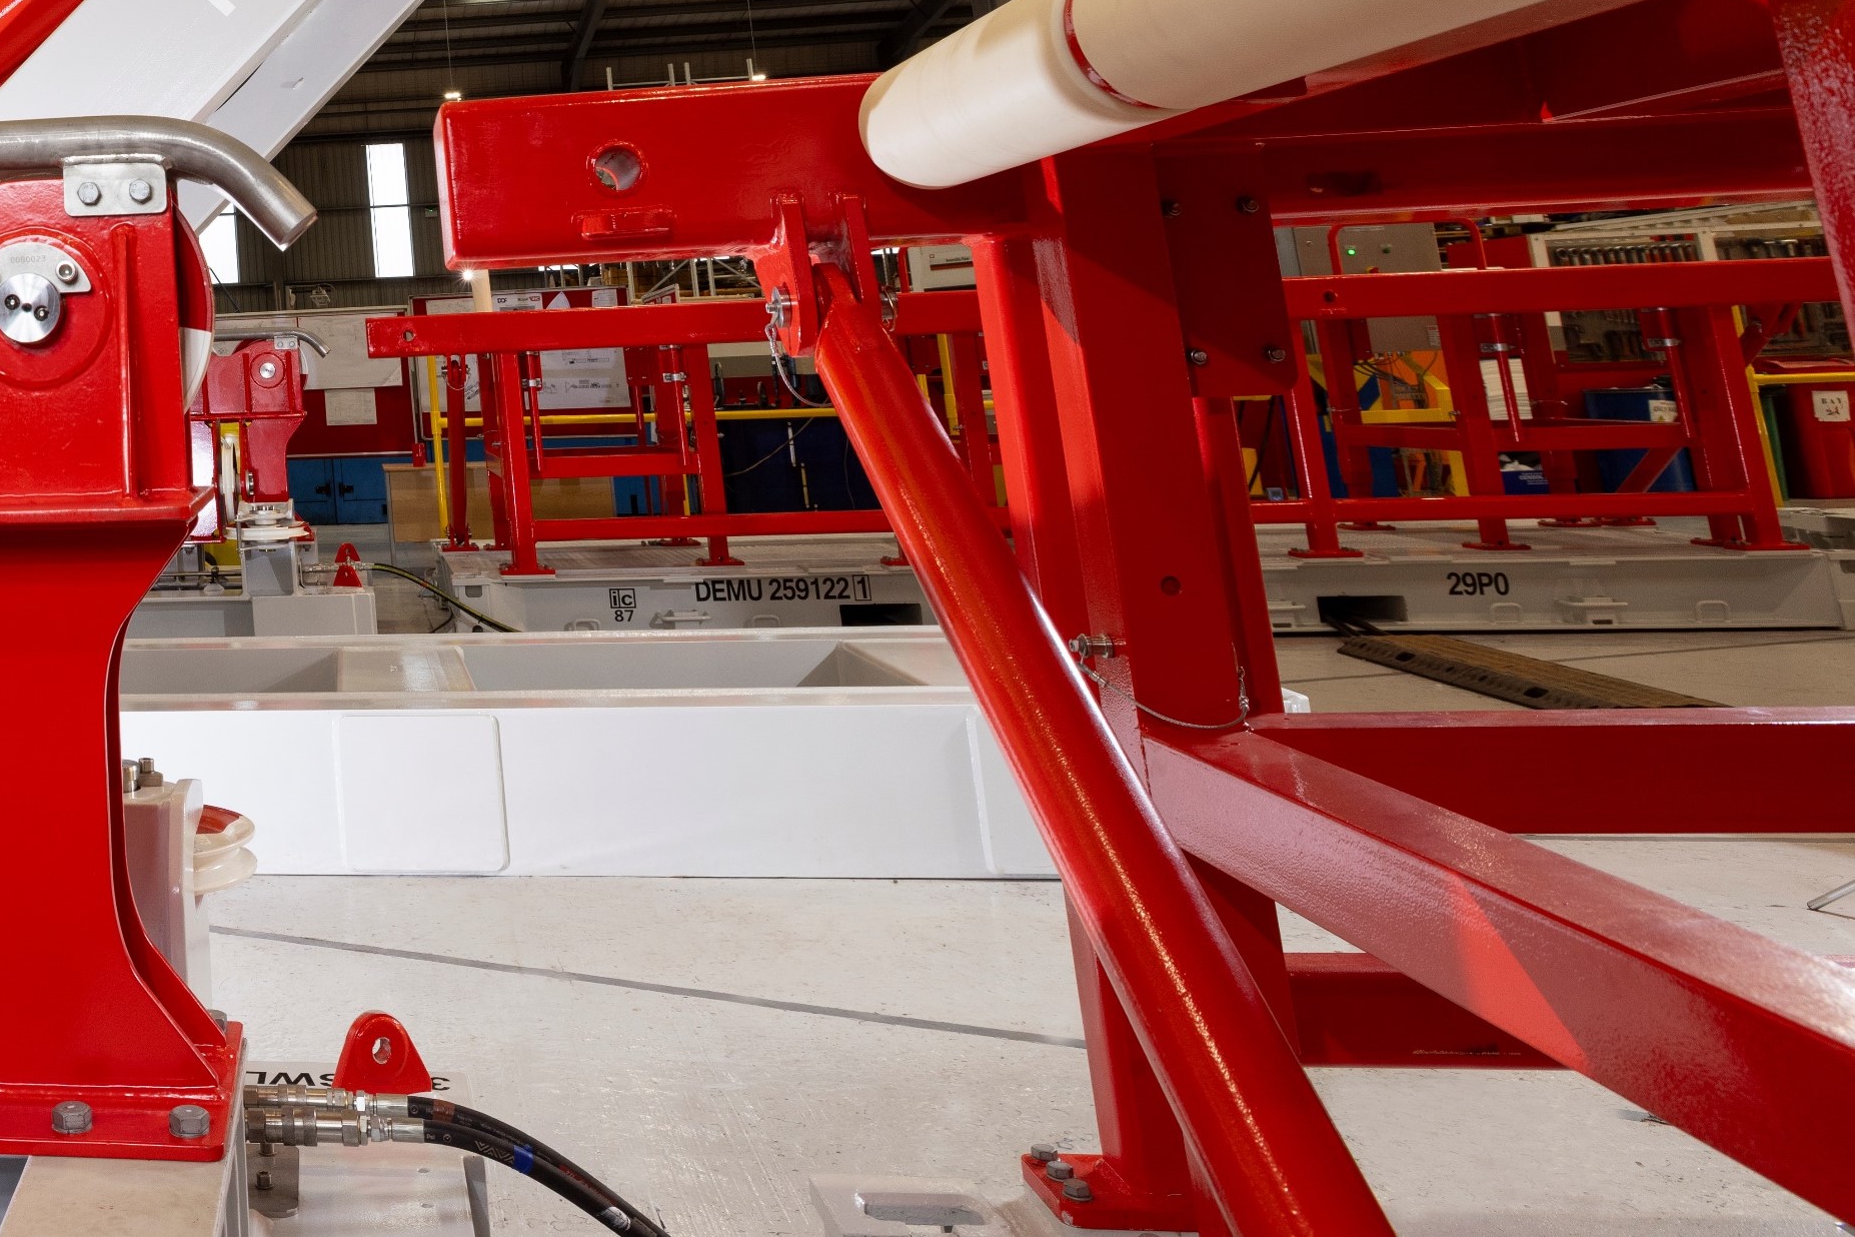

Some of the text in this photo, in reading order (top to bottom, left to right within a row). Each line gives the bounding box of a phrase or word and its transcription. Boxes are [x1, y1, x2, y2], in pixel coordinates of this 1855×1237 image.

[695, 578, 763, 602] DEMU
[768, 577, 851, 601] 259122
[614, 609, 634, 622] 87
